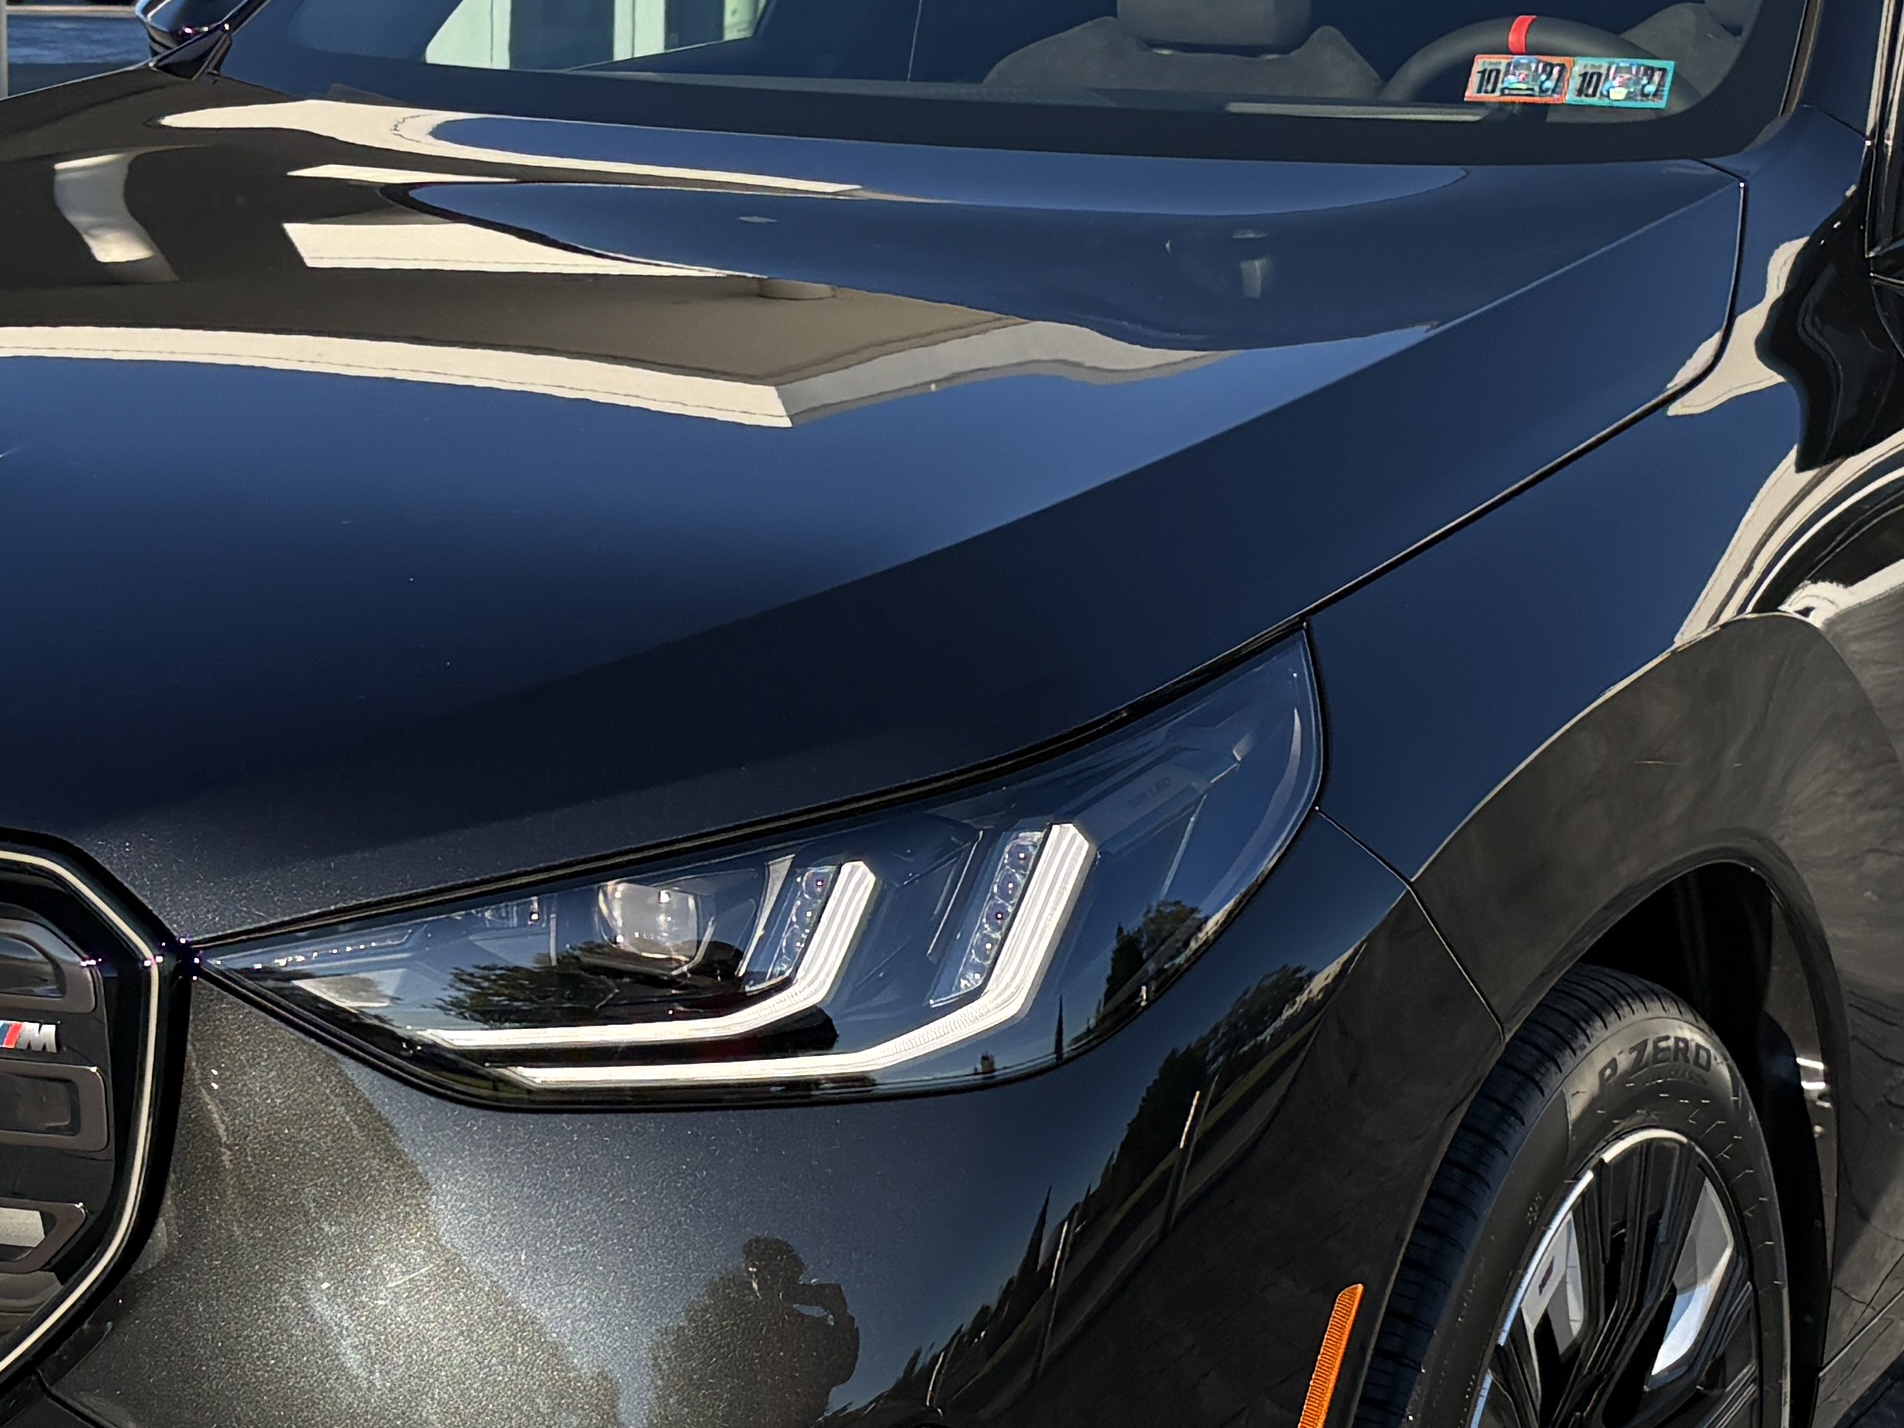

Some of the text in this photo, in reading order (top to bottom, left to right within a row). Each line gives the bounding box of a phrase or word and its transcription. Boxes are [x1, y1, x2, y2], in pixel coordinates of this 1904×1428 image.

[1476, 67, 1501, 95] 10
[1576, 70, 1603, 98] 10
[15, 1021, 58, 1053] M
[1628, 1034, 1712, 1073] ZERO
